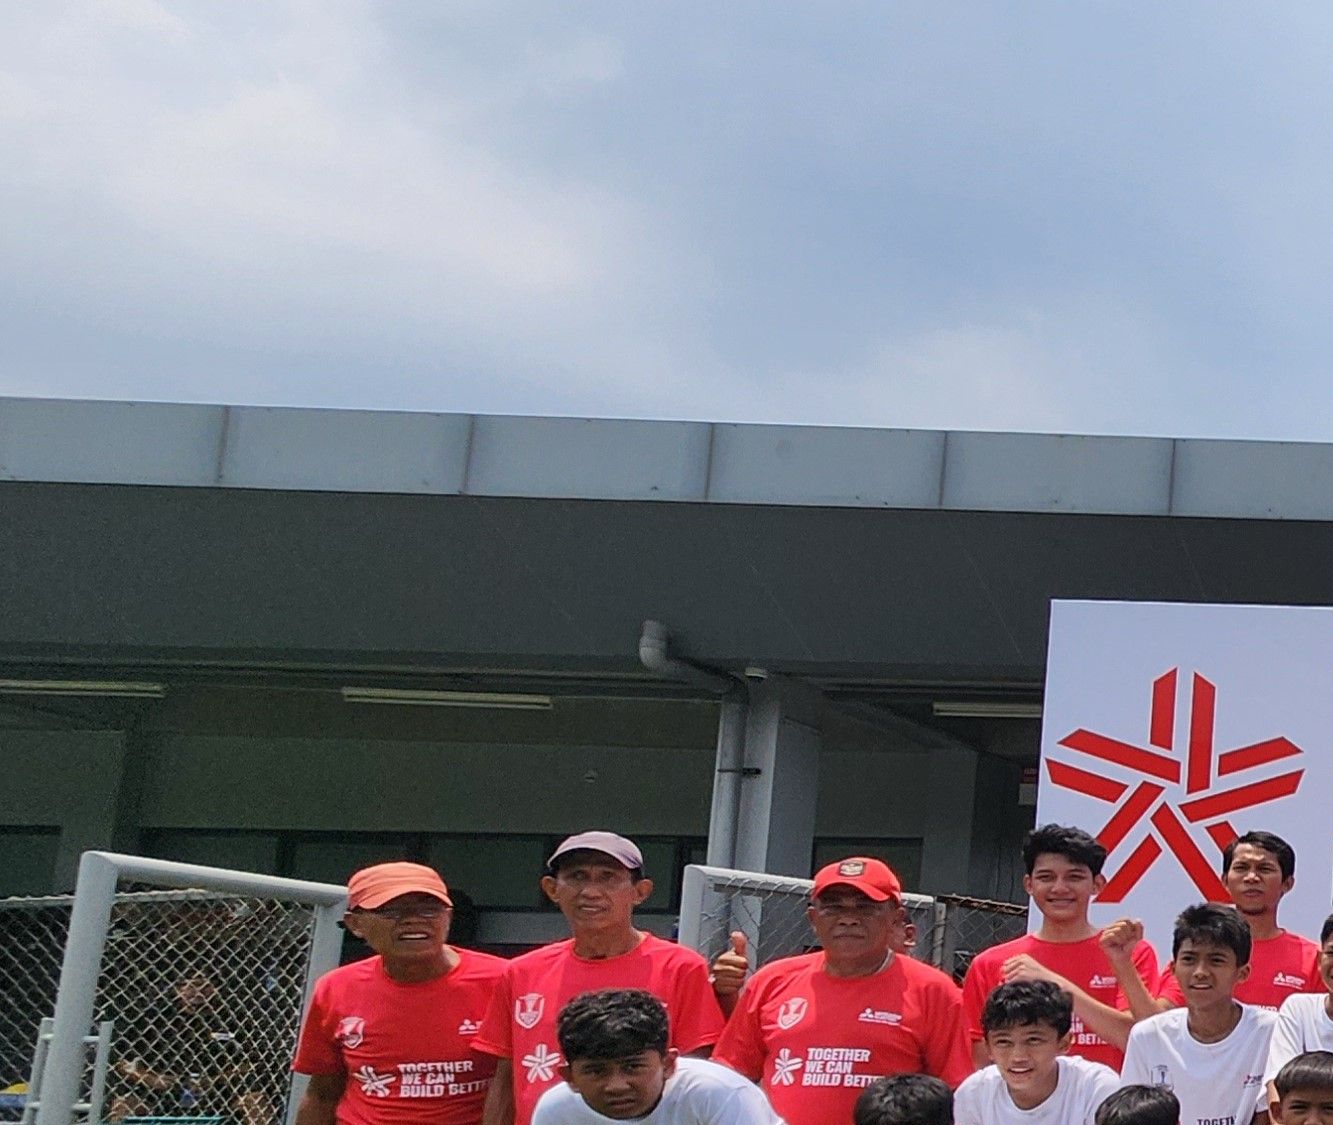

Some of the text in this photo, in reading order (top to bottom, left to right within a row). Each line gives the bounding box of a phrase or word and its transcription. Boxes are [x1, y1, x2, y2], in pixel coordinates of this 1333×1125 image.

[807, 1047, 871, 1062] TOGETHER
[397, 1060, 474, 1073] TOGETHER
[805, 1060, 854, 1074] WE CAN
[402, 1073, 455, 1085] WE CAN
[802, 1073, 841, 1087] BUILD
[399, 1084, 445, 1098] BUILD
